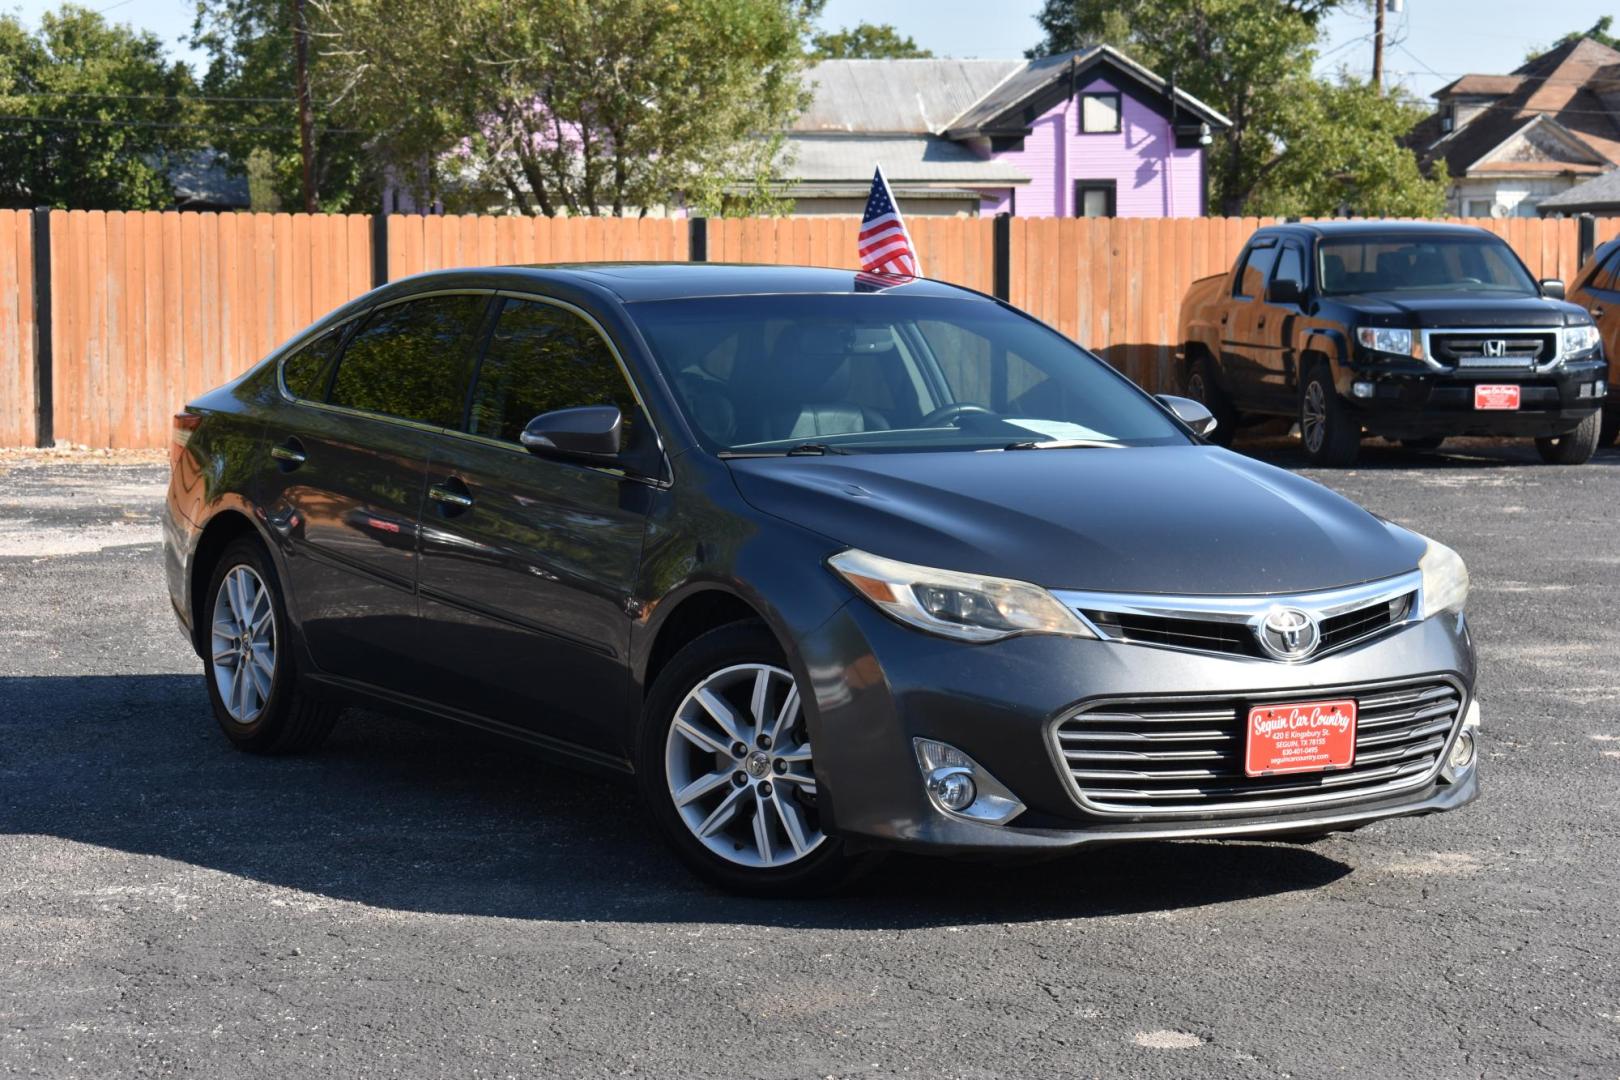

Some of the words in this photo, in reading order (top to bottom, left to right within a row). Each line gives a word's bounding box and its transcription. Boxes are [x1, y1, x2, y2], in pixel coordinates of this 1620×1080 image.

[1254, 715, 1288, 738] Seguin
[1289, 709, 1310, 729] Car
[1310, 707, 1350, 733] Country
[1291, 730, 1321, 739] Kingsbury
